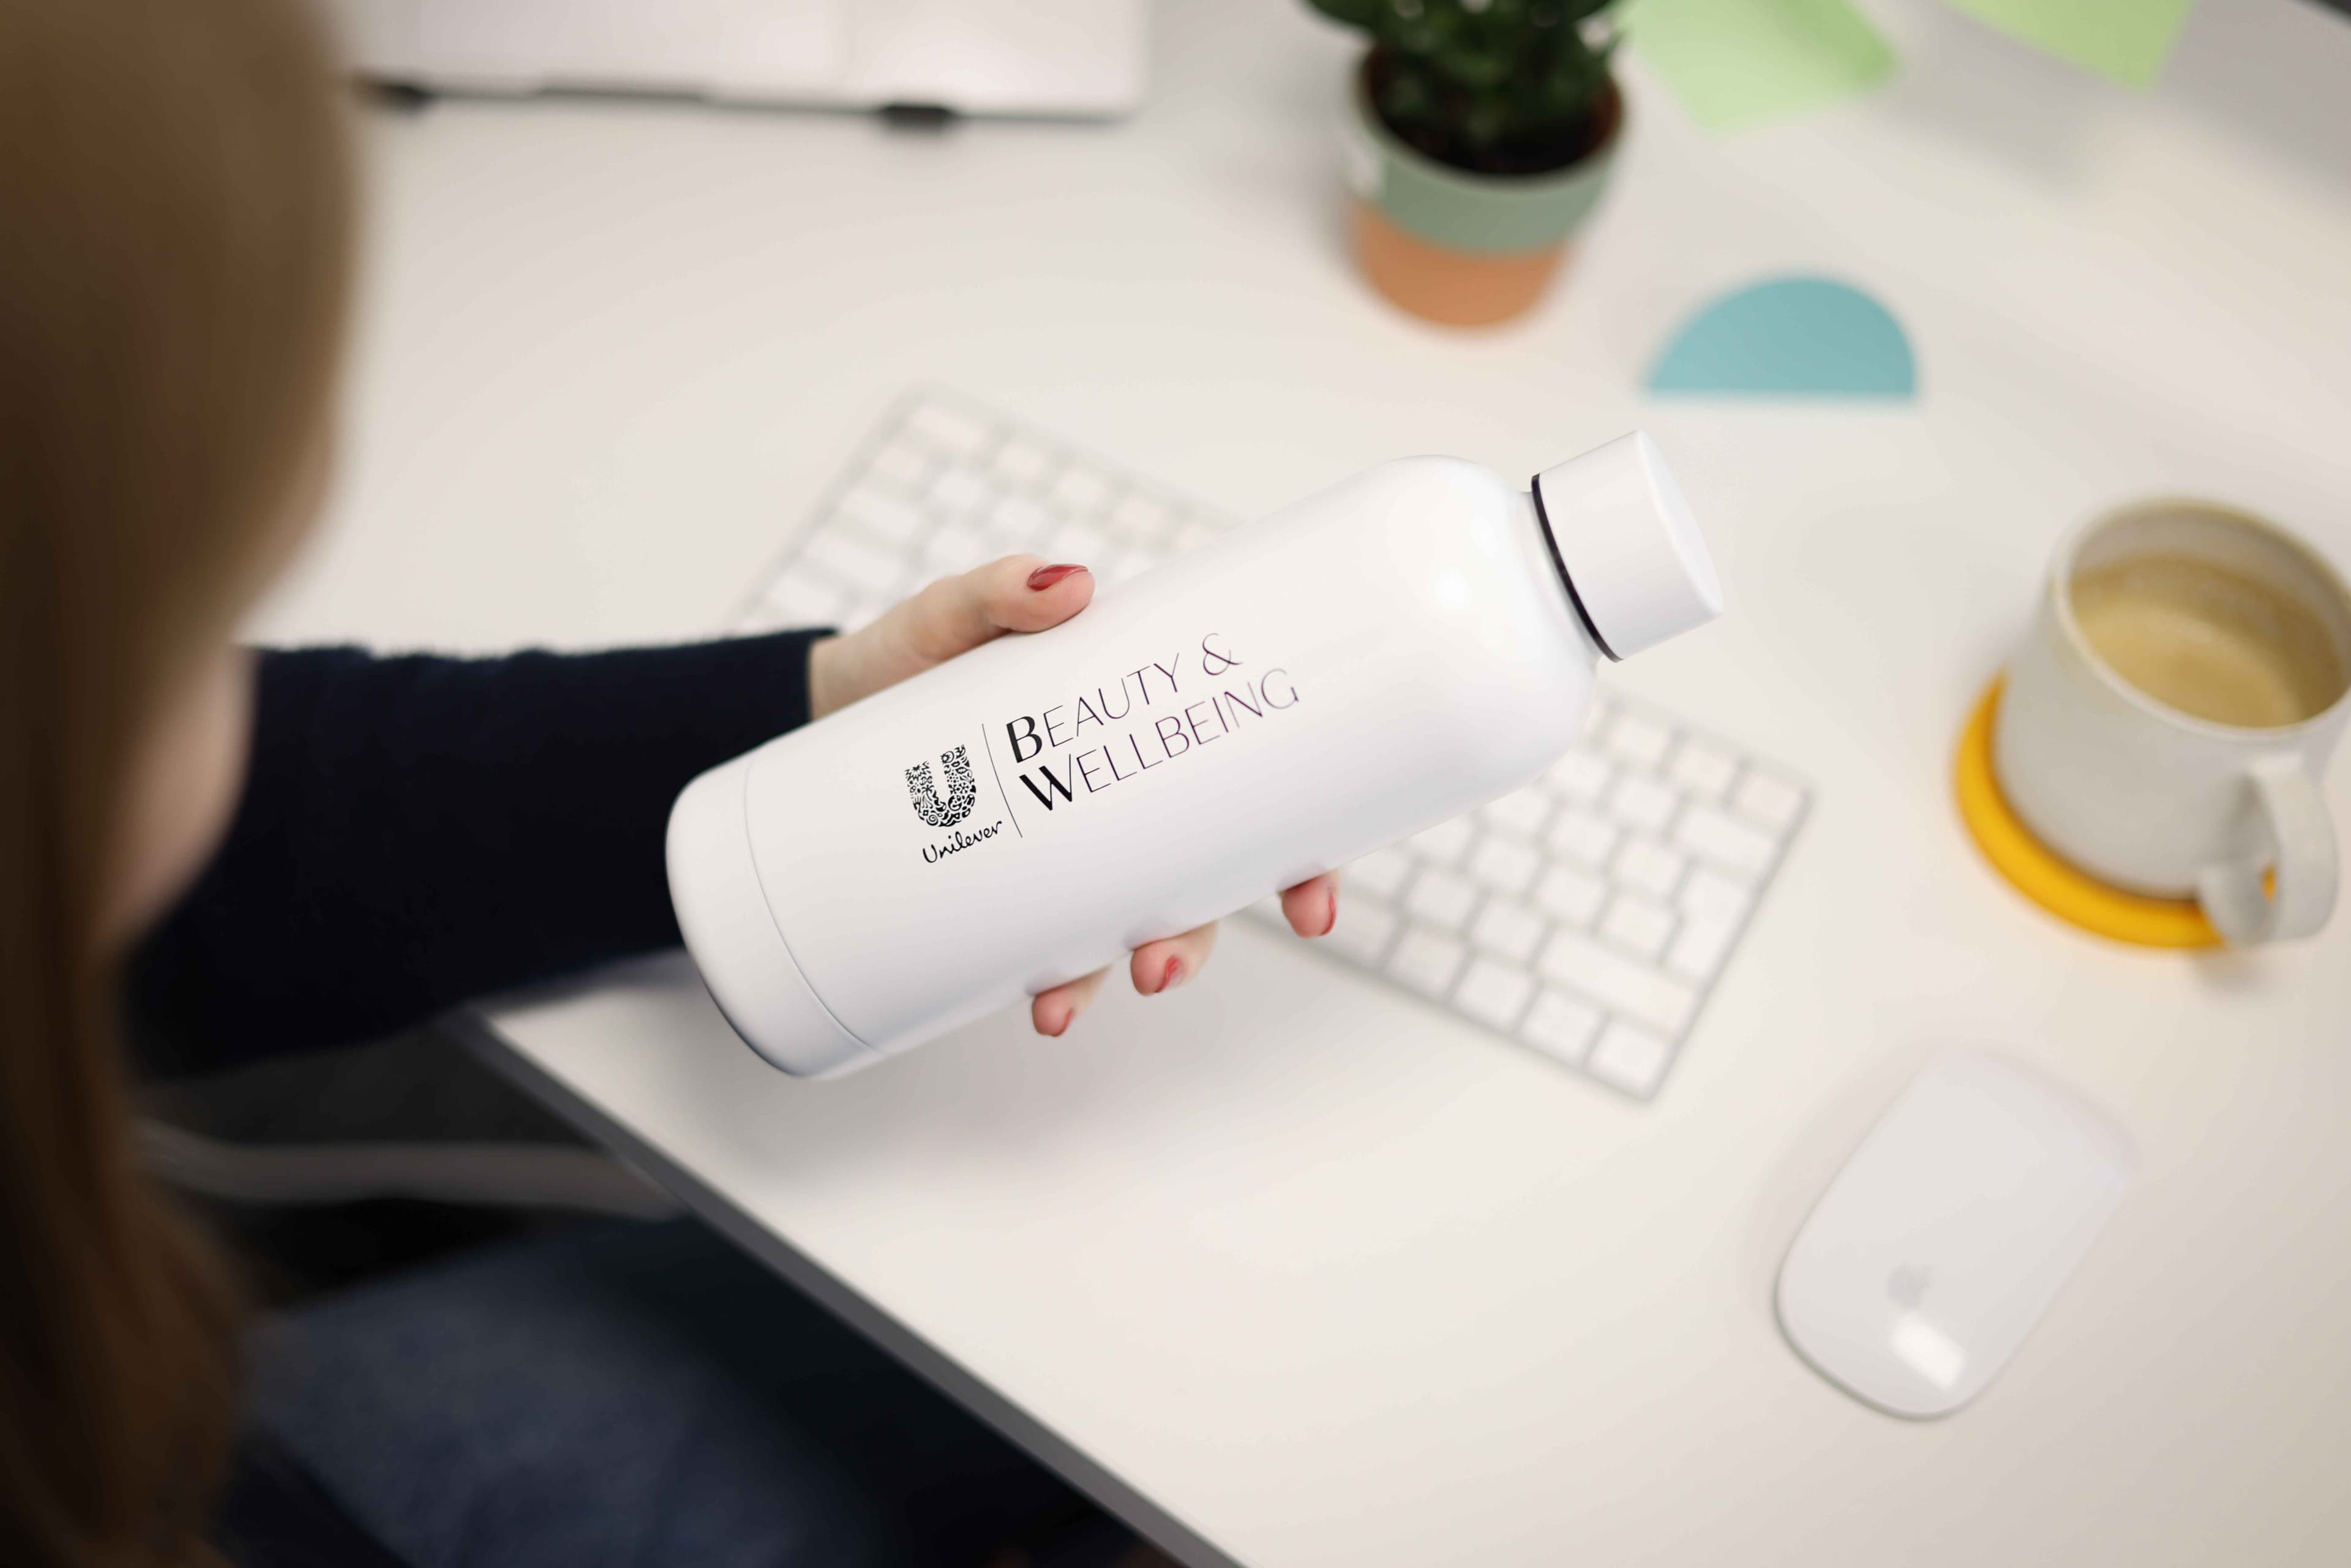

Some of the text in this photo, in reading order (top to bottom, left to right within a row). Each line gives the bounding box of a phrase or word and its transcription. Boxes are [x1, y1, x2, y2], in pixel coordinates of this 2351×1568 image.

[1005, 632, 1243, 764] BEAUTY &
[1019, 667, 1300, 811] WELLBEING
[922, 820, 1003, 863] Unilever
